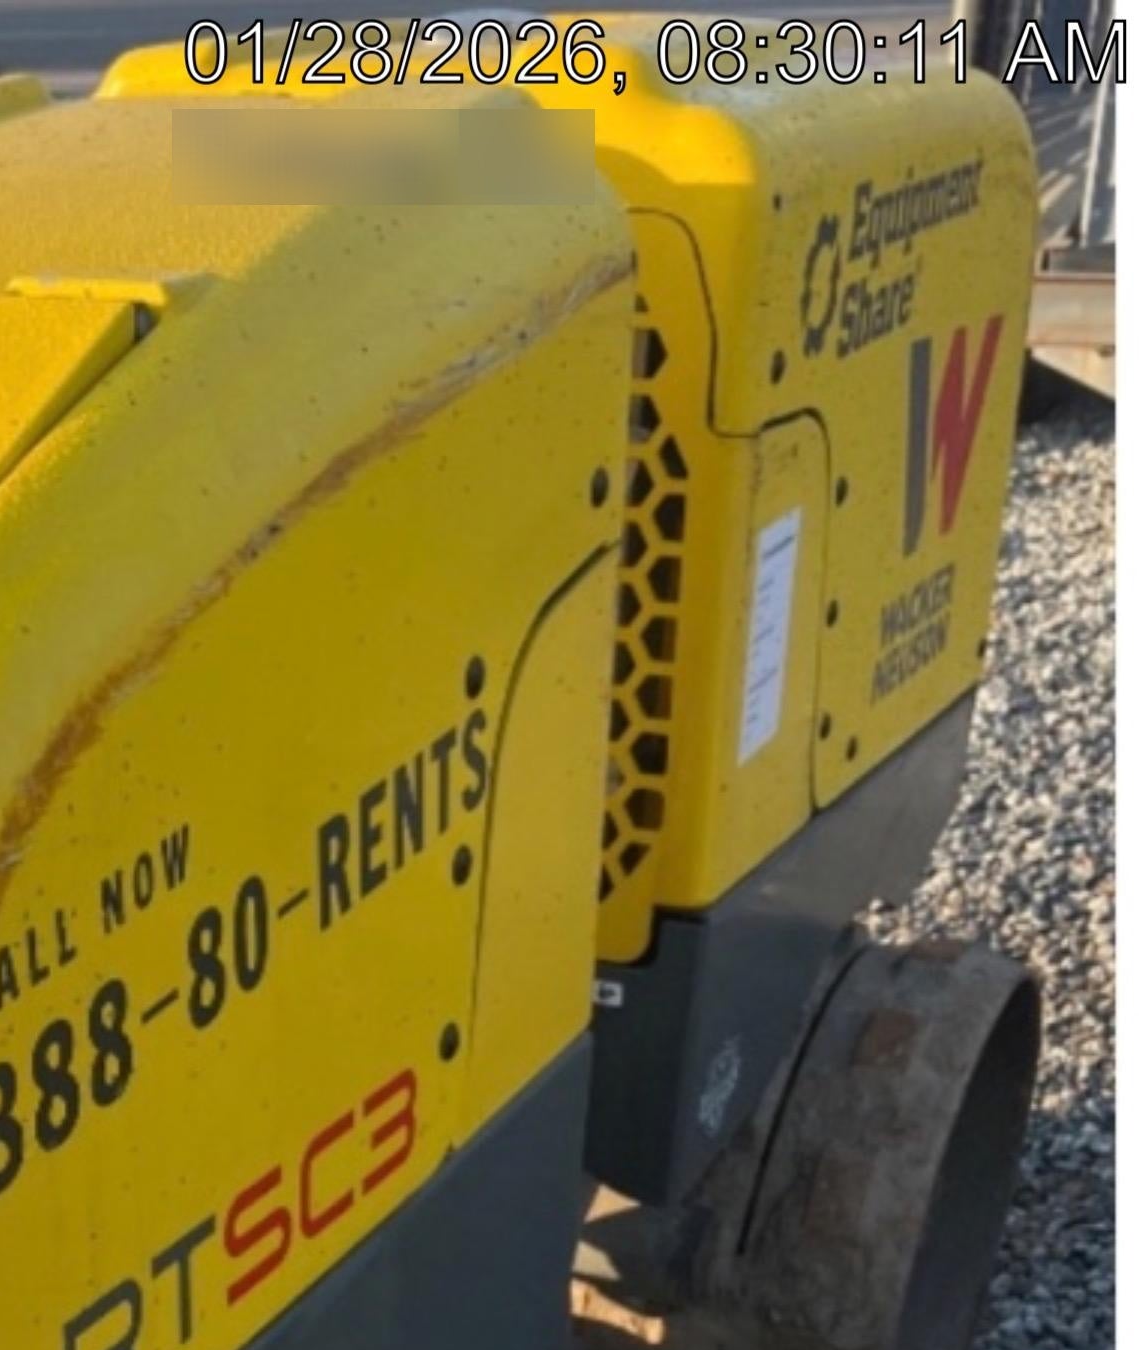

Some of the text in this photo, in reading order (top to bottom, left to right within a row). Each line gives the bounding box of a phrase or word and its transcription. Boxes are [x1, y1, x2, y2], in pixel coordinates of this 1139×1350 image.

[848, 152, 984, 270] Equipment
[836, 272, 917, 360] Share
[98, 824, 190, 934] NOW
